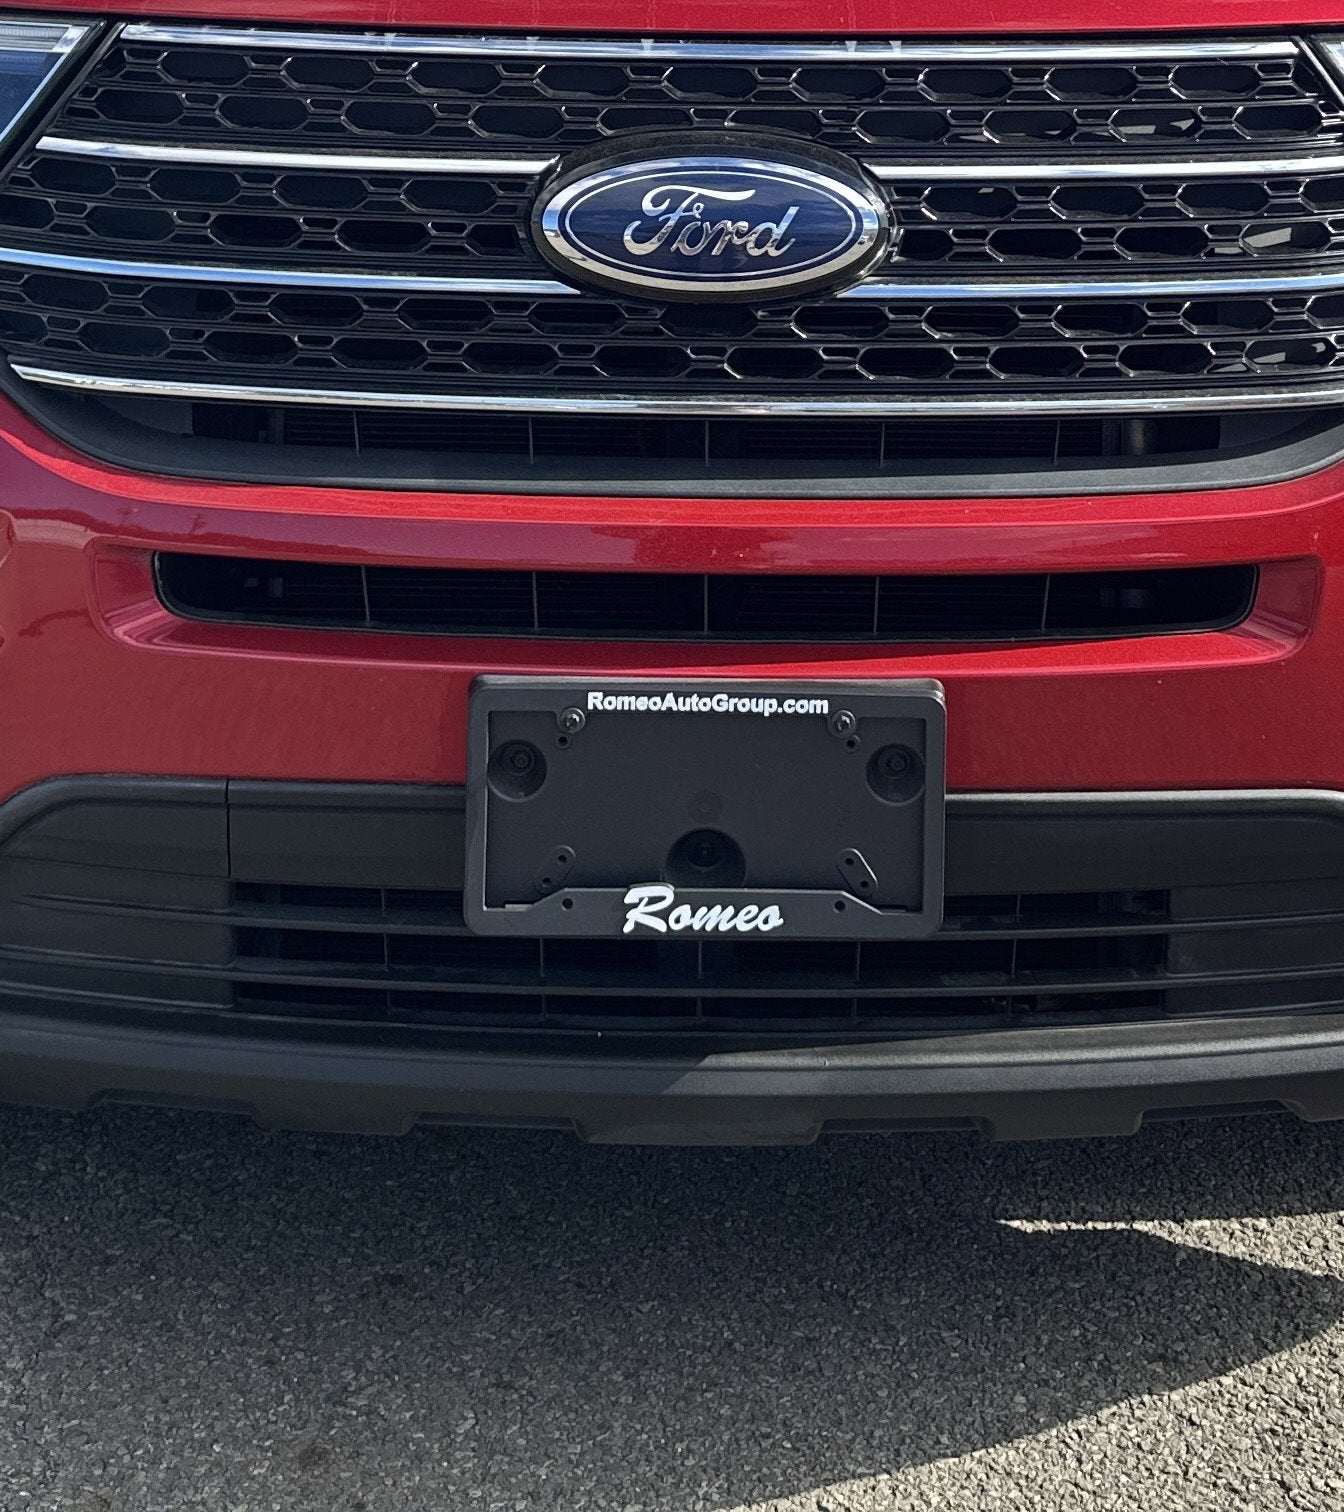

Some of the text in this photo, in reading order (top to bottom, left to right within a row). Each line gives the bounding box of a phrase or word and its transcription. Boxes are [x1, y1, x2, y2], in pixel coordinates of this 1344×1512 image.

[622, 184, 801, 258] Ford
[586, 691, 830, 717] RomeoAutoGroup.com
[622, 884, 785, 934] Romeo
